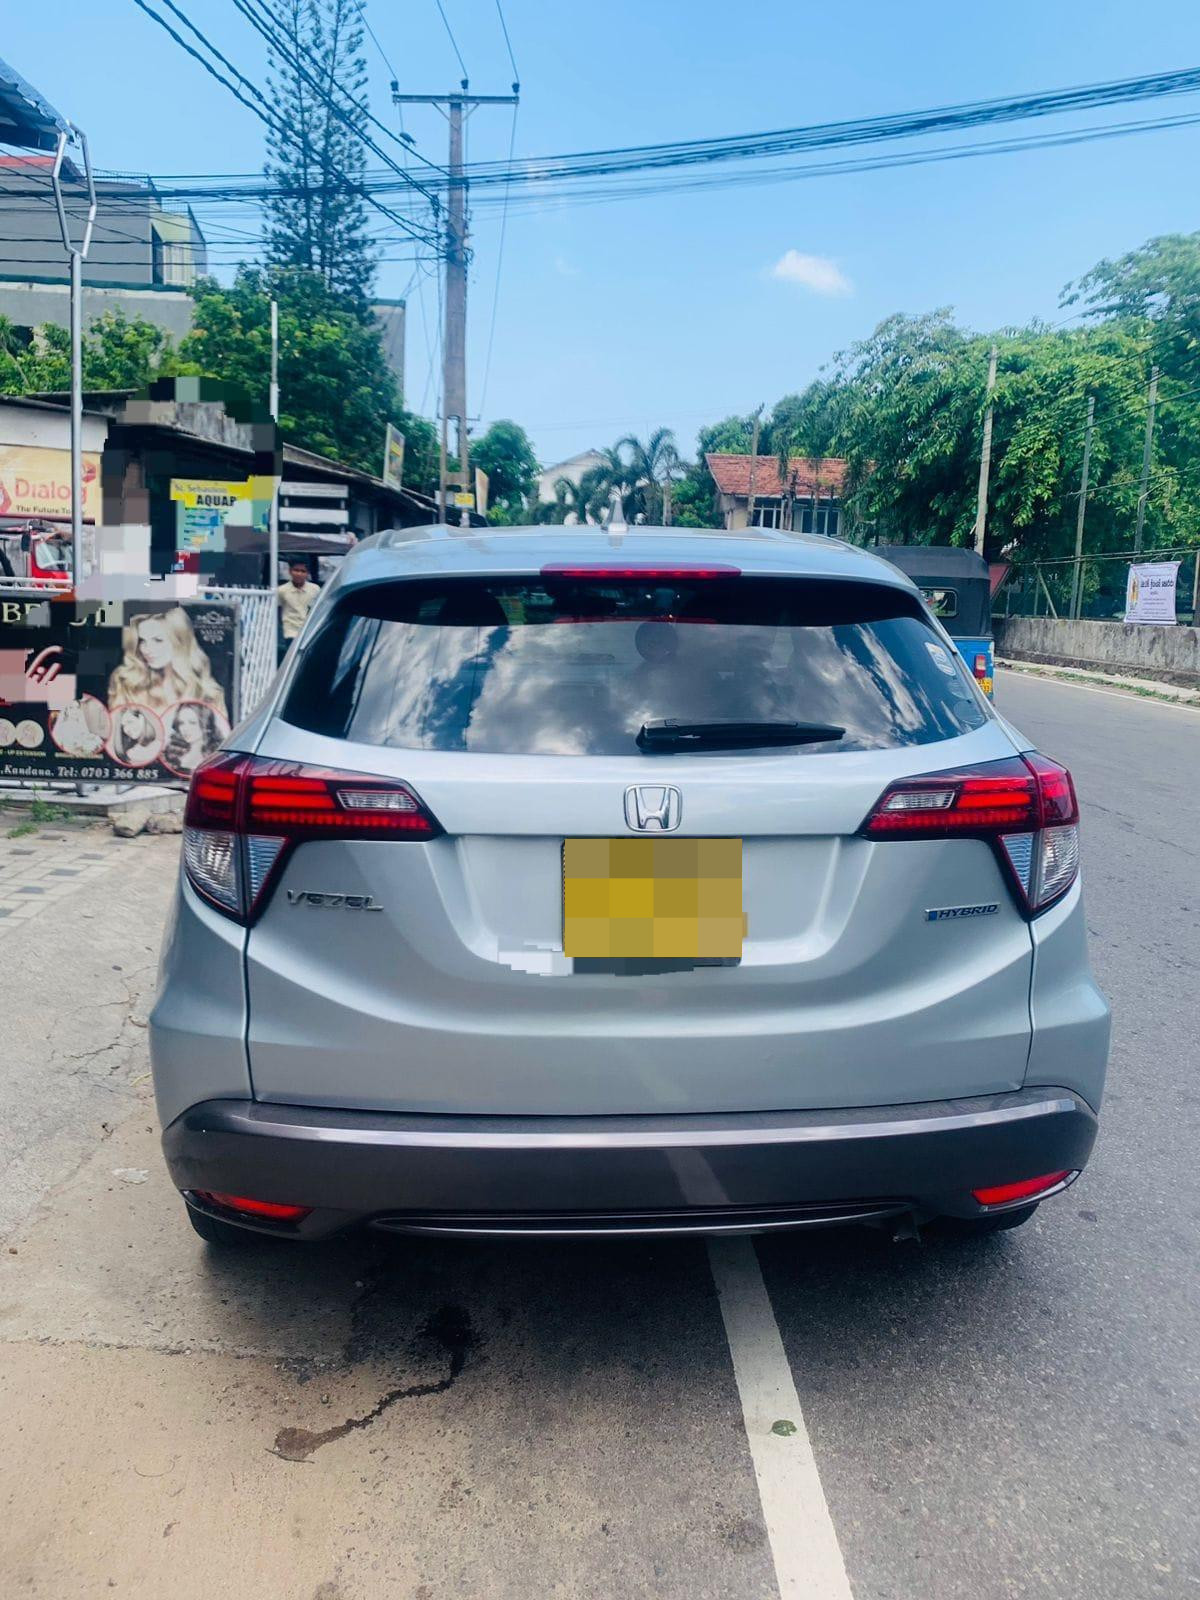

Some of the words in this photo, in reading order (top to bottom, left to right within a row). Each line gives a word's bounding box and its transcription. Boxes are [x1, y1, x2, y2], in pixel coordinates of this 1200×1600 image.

[33, 505, 59, 514] Future
[57, 766, 78, 777] Tel:
[80, 767, 110, 778] 0703
[112, 768, 134, 779] 366
[136, 769, 159, 780] 885
[287, 889, 384, 911] VEZEL
[938, 904, 998, 918] HYBRID
